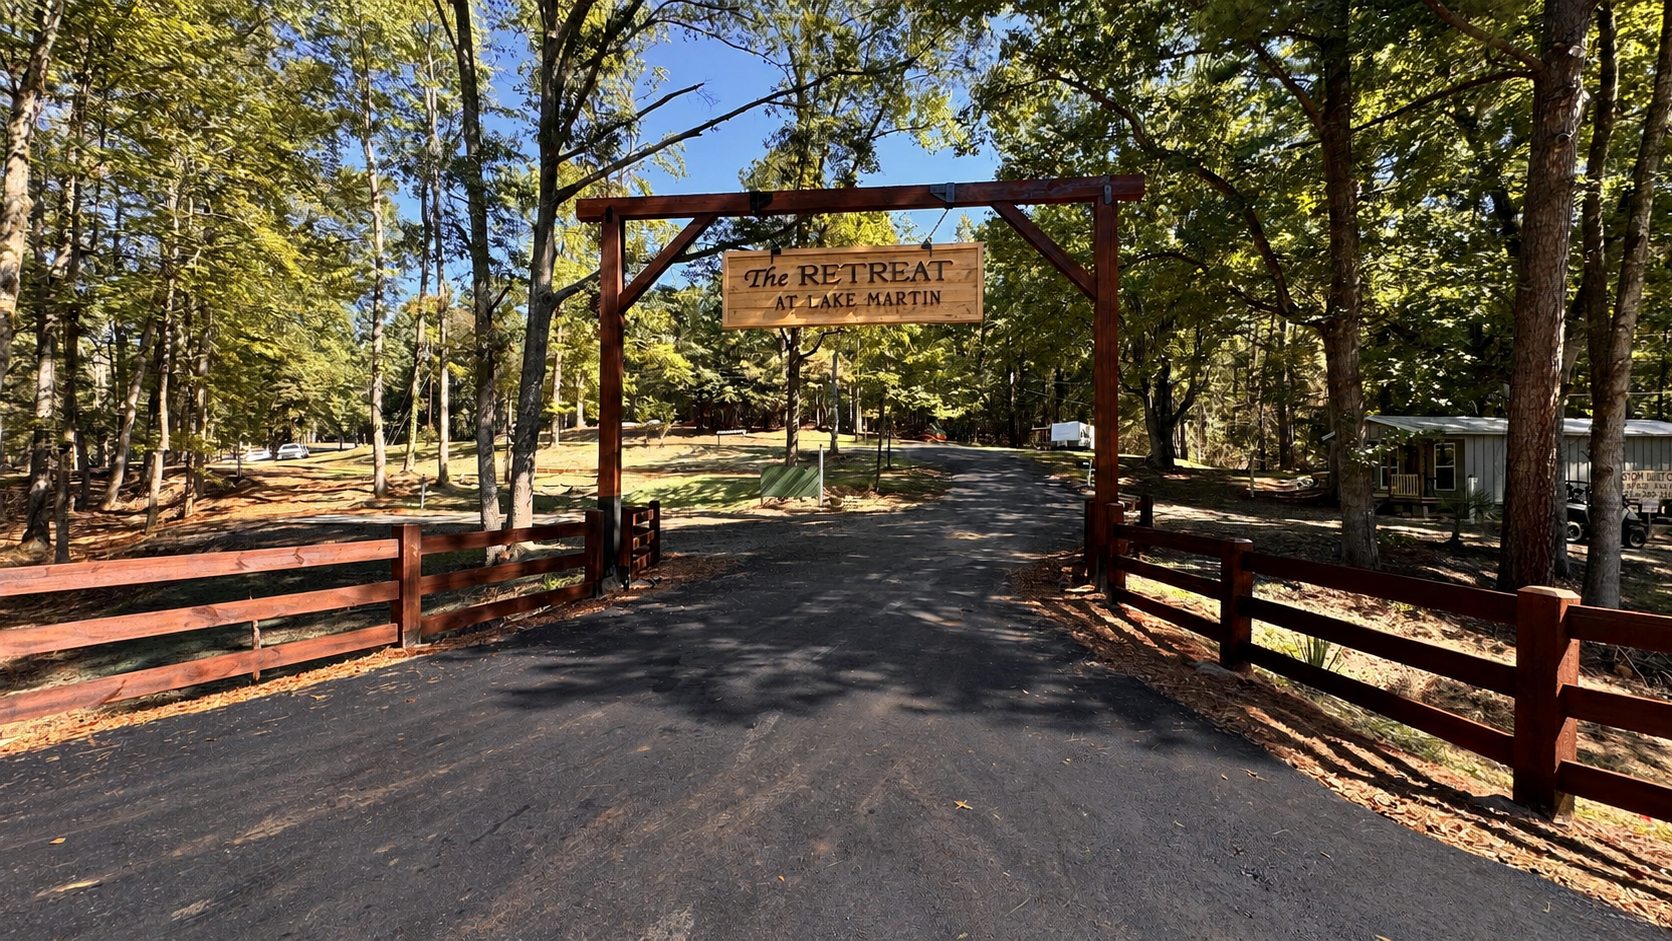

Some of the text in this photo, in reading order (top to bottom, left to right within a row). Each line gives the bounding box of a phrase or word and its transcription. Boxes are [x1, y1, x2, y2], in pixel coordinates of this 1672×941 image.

[744, 260, 954, 288] The RETREAT
[775, 290, 941, 311] AT LAKE MARTIN
